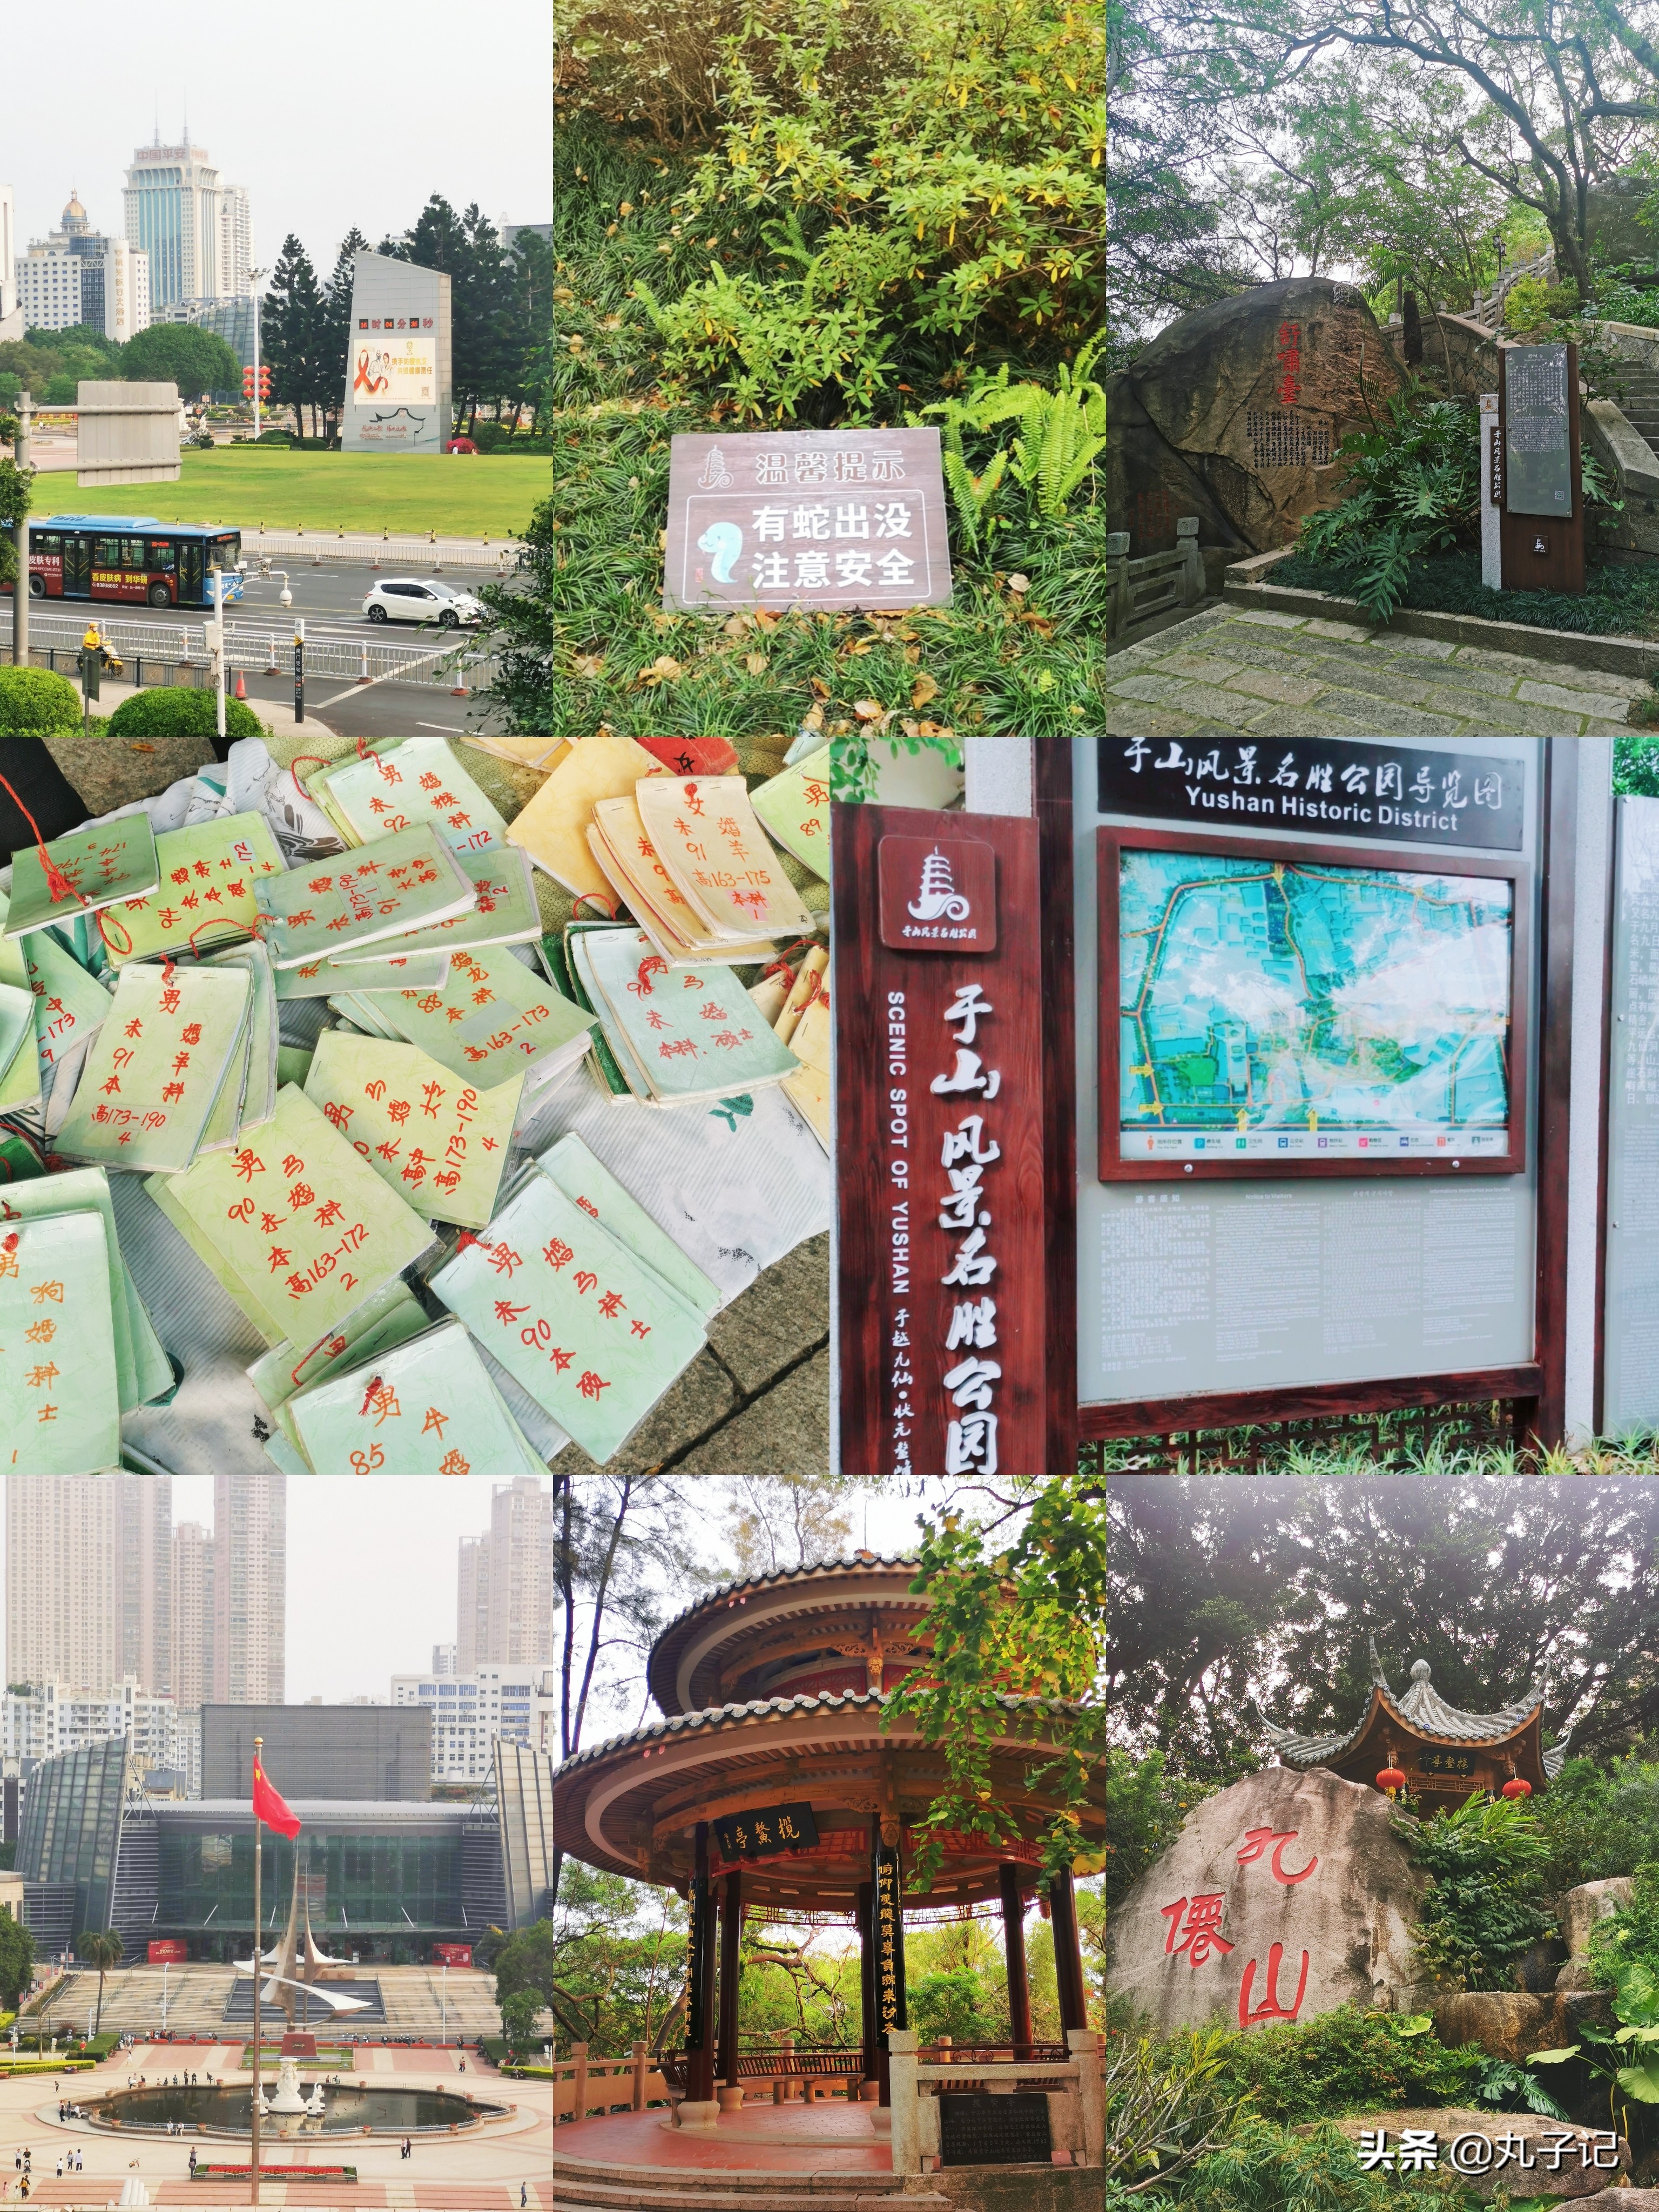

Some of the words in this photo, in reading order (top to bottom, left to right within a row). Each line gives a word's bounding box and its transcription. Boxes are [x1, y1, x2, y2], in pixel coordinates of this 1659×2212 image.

[756, 450, 906, 485] 温馨提示
[1493, 430, 1501, 498] 于山风景名胜公园
[752, 503, 913, 543] 有蛇出没
[92, 572, 122, 583] 看皮肤病
[125, 575, 148, 585] 到华研
[752, 548, 916, 589] 注意安全
[380, 765, 402, 784] 男
[1124, 737, 1503, 811] 于山风景名胜公园导览图
[384, 815, 409, 831] 92
[1186, 786, 1275, 814] Yushan
[1282, 796, 1371, 824] Historic
[1378, 806, 1458, 832] District
[696, 871, 770, 886] 高163-175
[902, 925, 977, 940] 于山风景名胜公园
[159, 989, 180, 1014] 男
[465, 1006, 549, 1061] 高163-173
[887, 991, 907, 1076] SCENIC
[113, 1048, 134, 1069] 91
[92, 1105, 166, 1130] 高173-190
[889, 1089, 908, 1148] SPOT
[232, 1149, 266, 1182] 男
[891, 1160, 908, 1189] OF
[228, 1198, 254, 1224] 90
[930, 983, 1002, 1475] 于山风景名胜公园
[282, 1221, 368, 1299] 高163-172
[487, 1241, 523, 1279] 男
[891, 1201, 909, 1294] YUSHAN
[340, 1273, 358, 1291] 2
[521, 1319, 550, 1350] 90
